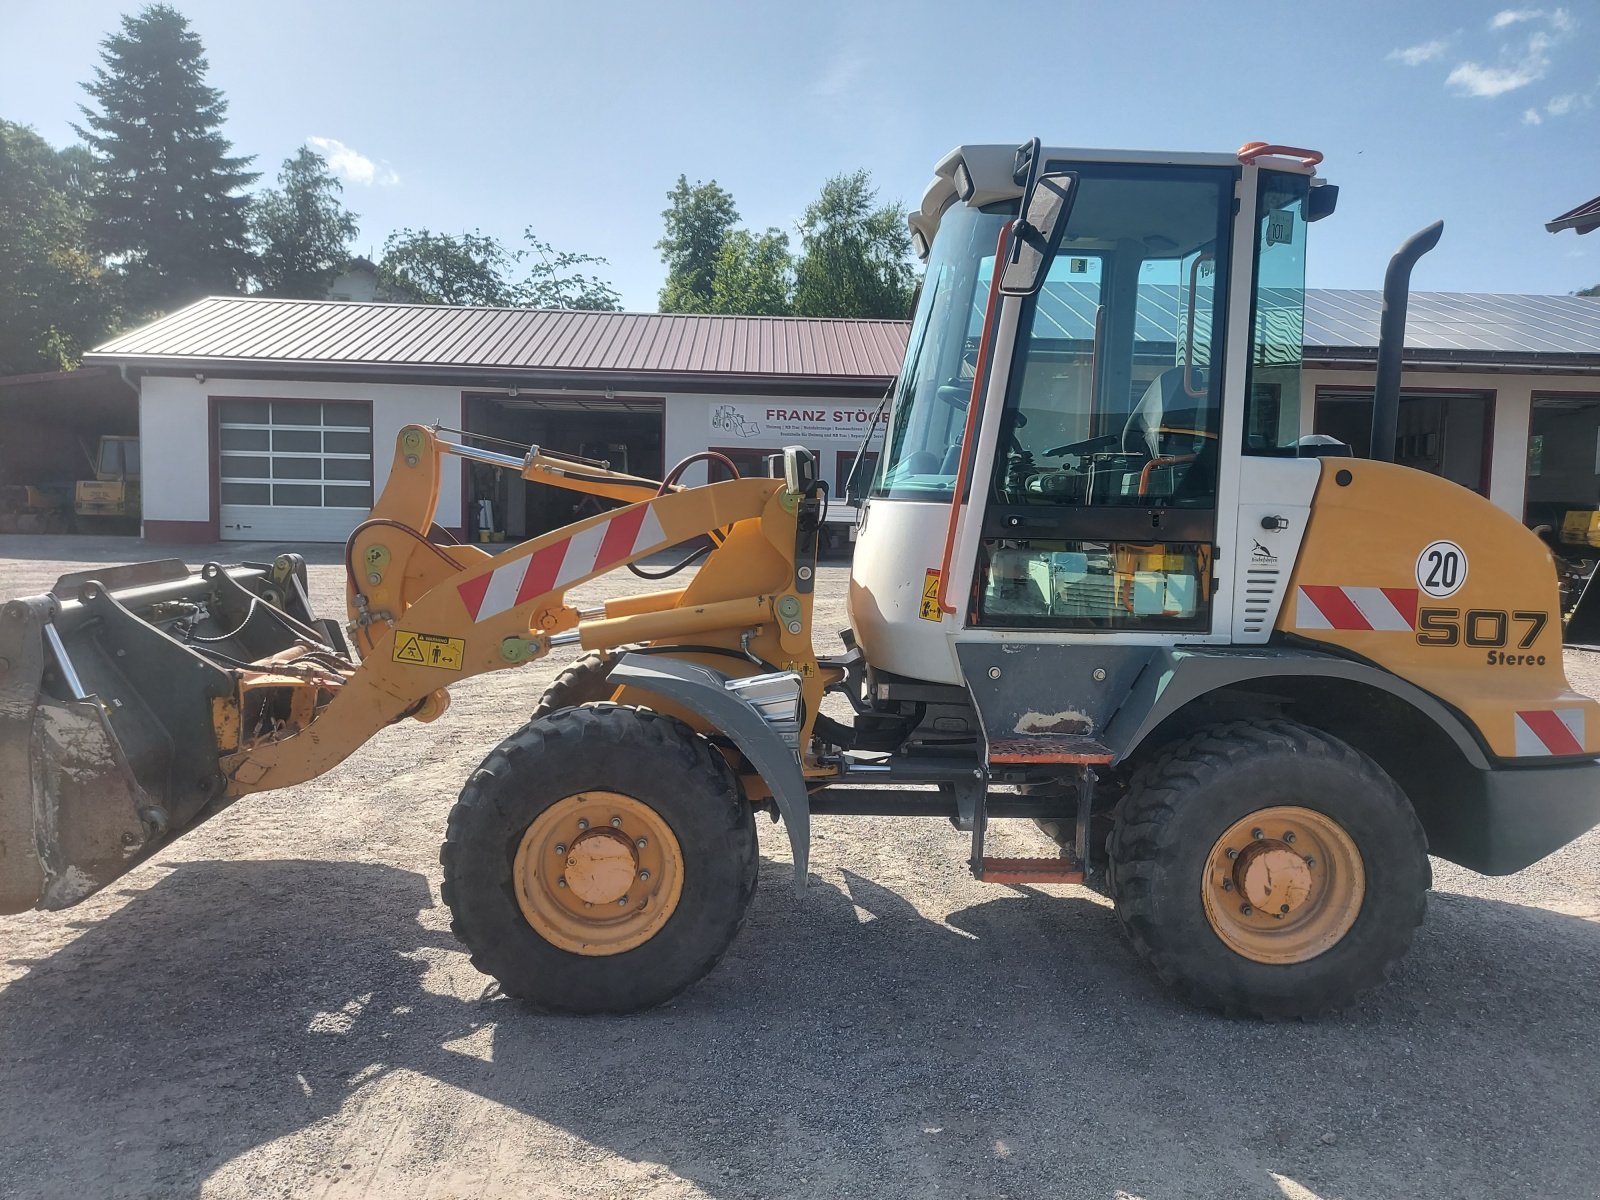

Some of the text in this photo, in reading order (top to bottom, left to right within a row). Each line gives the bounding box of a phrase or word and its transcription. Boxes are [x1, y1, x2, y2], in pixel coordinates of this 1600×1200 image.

[766, 409, 826, 422] FRANZ
[1425, 550, 1458, 588] 20
[1416, 607, 1548, 649] 507
[1486, 650, 1546, 666] Stereo
